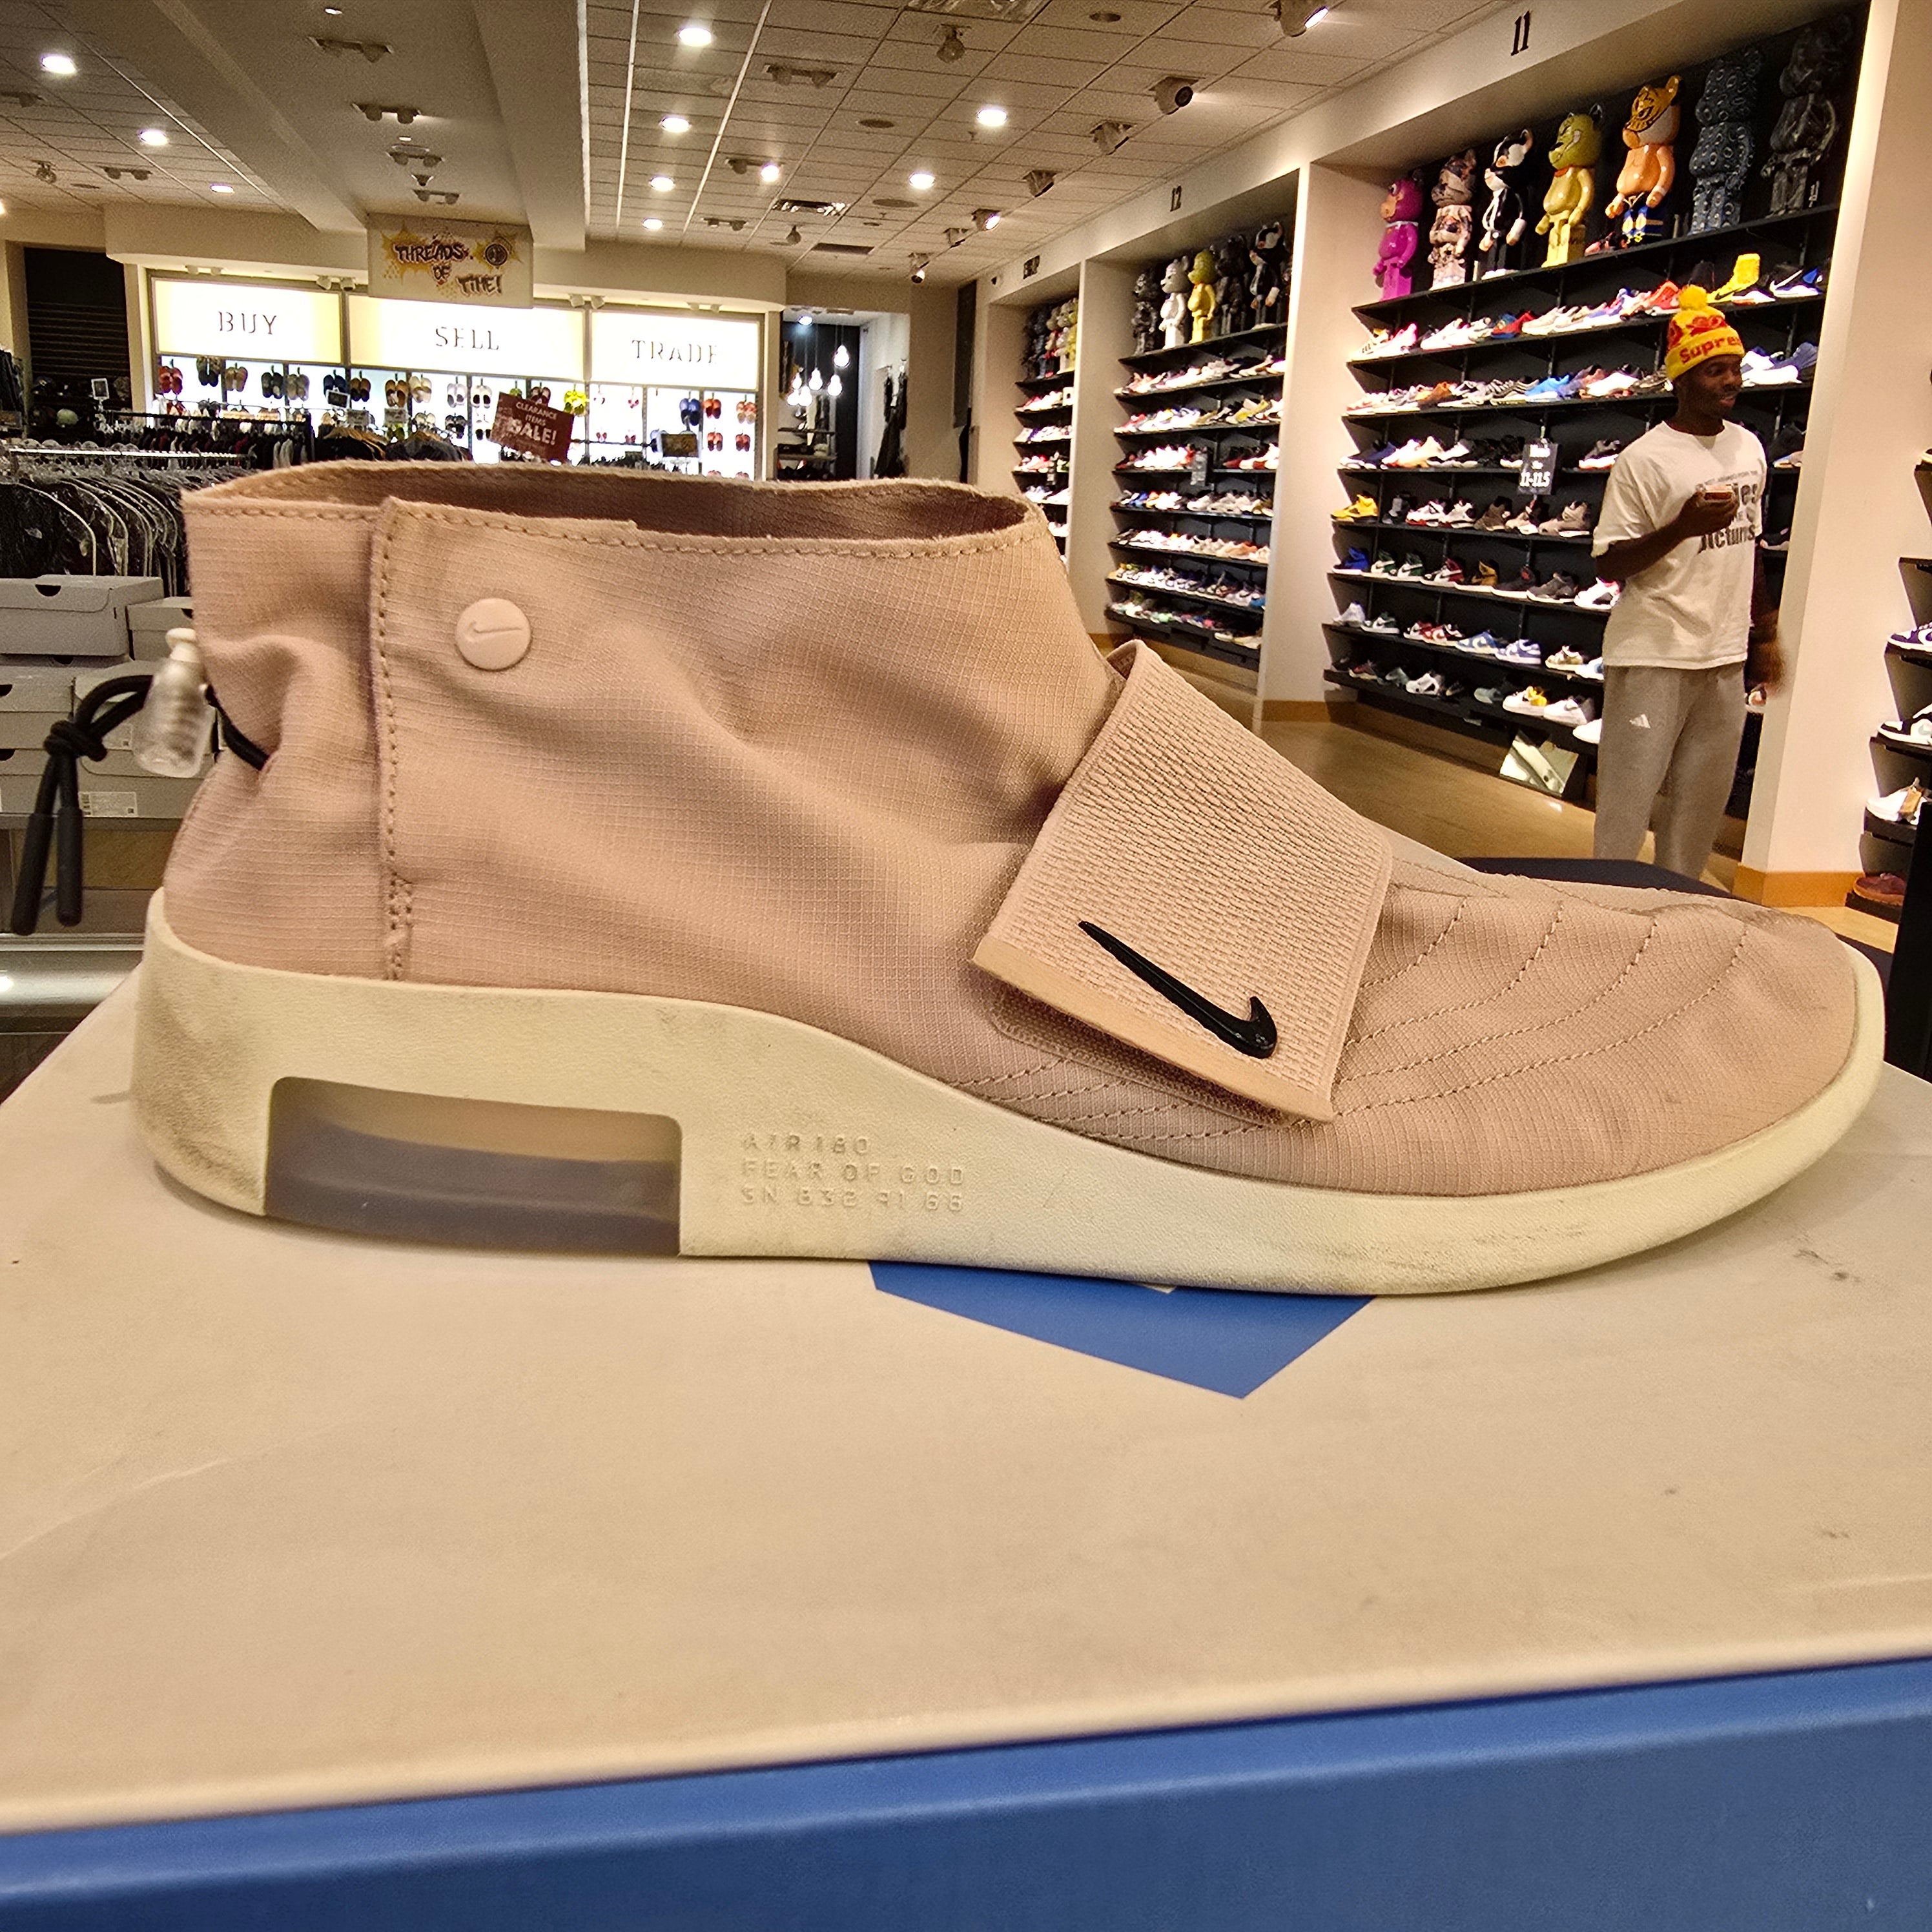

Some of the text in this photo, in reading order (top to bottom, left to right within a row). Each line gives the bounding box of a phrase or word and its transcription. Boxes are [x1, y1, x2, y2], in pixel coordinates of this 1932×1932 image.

[1510, 10, 1530, 56] 11
[1169, 185, 1182, 212] 12
[432, 263, 451, 280] OF
[218, 311, 277, 335] BUY
[435, 326, 499, 350] SELL
[1680, 336, 1741, 364] Supre
[632, 340, 717, 364] TRADE
[515, 402, 557, 420] CLEARANCE
[507, 417, 557, 446] SALE!
[743, 1134, 869, 1156] AIR 180
[743, 1158, 964, 1186] FEAR OF GOD
[741, 1184, 778, 1204] SN
